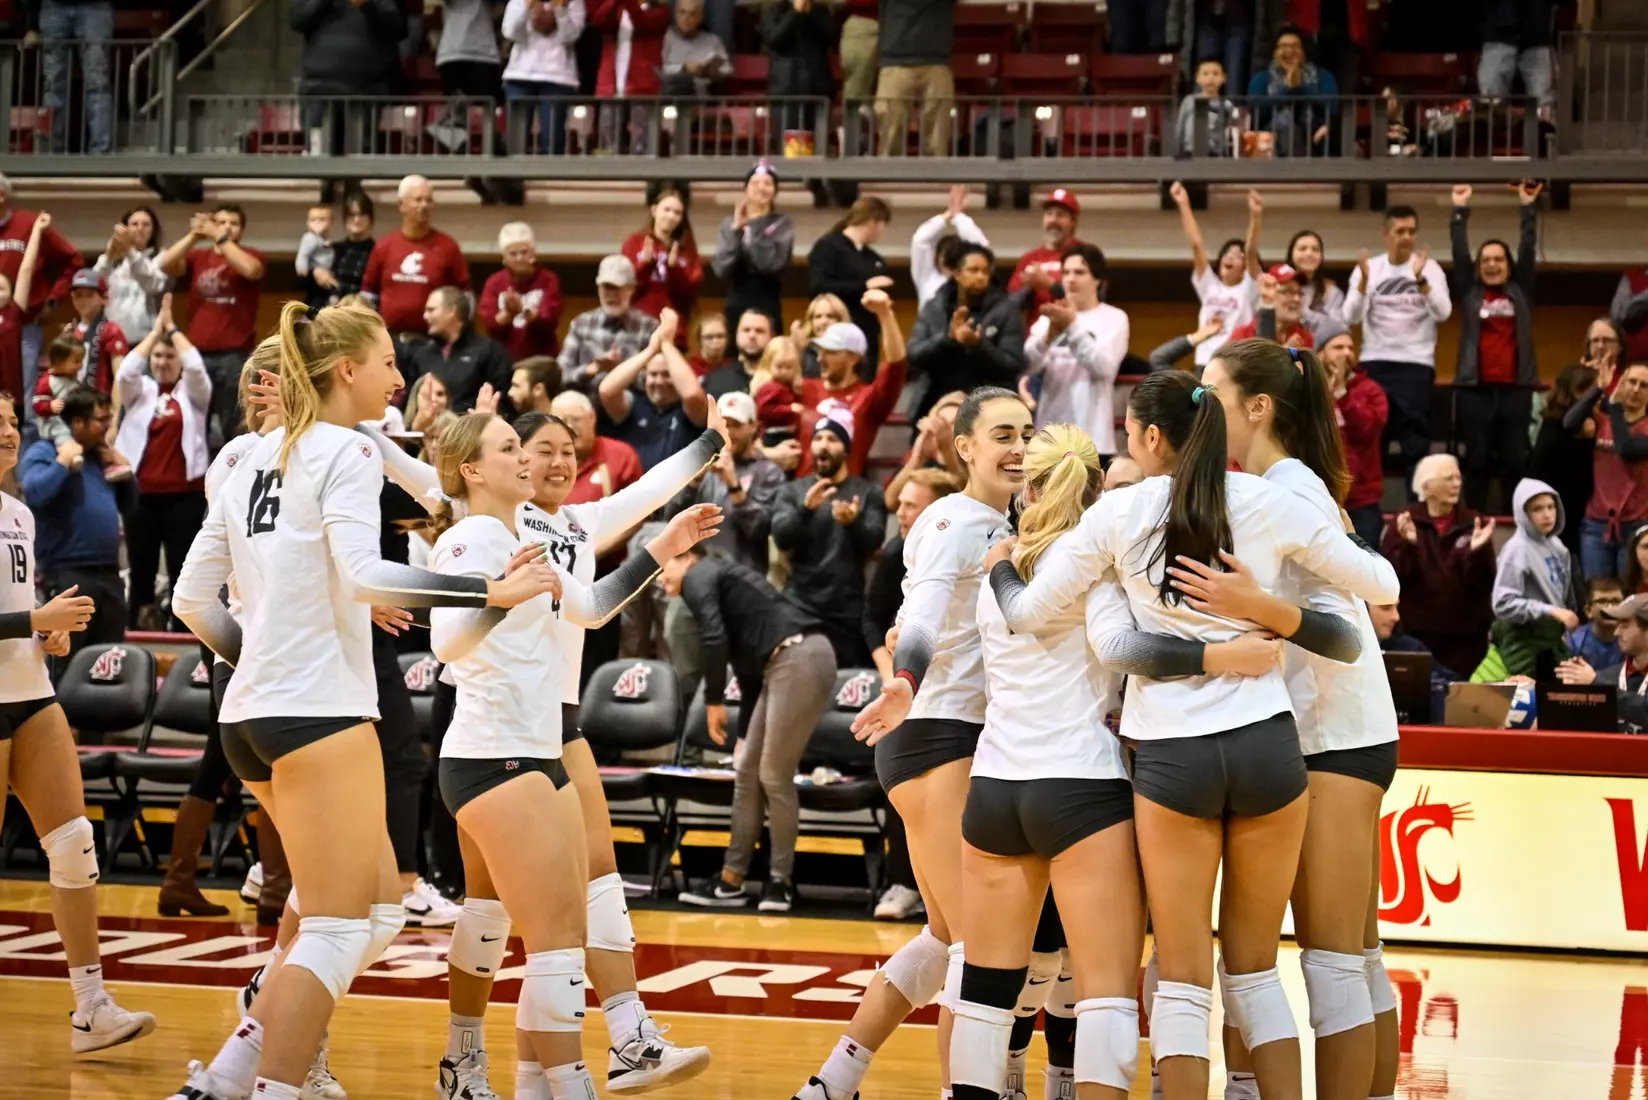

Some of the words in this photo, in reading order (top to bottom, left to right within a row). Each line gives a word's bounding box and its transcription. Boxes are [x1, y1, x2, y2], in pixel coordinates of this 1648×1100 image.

[246, 468, 283, 538] 16
[7, 544, 27, 583] 19
[550, 540, 576, 575] 17
